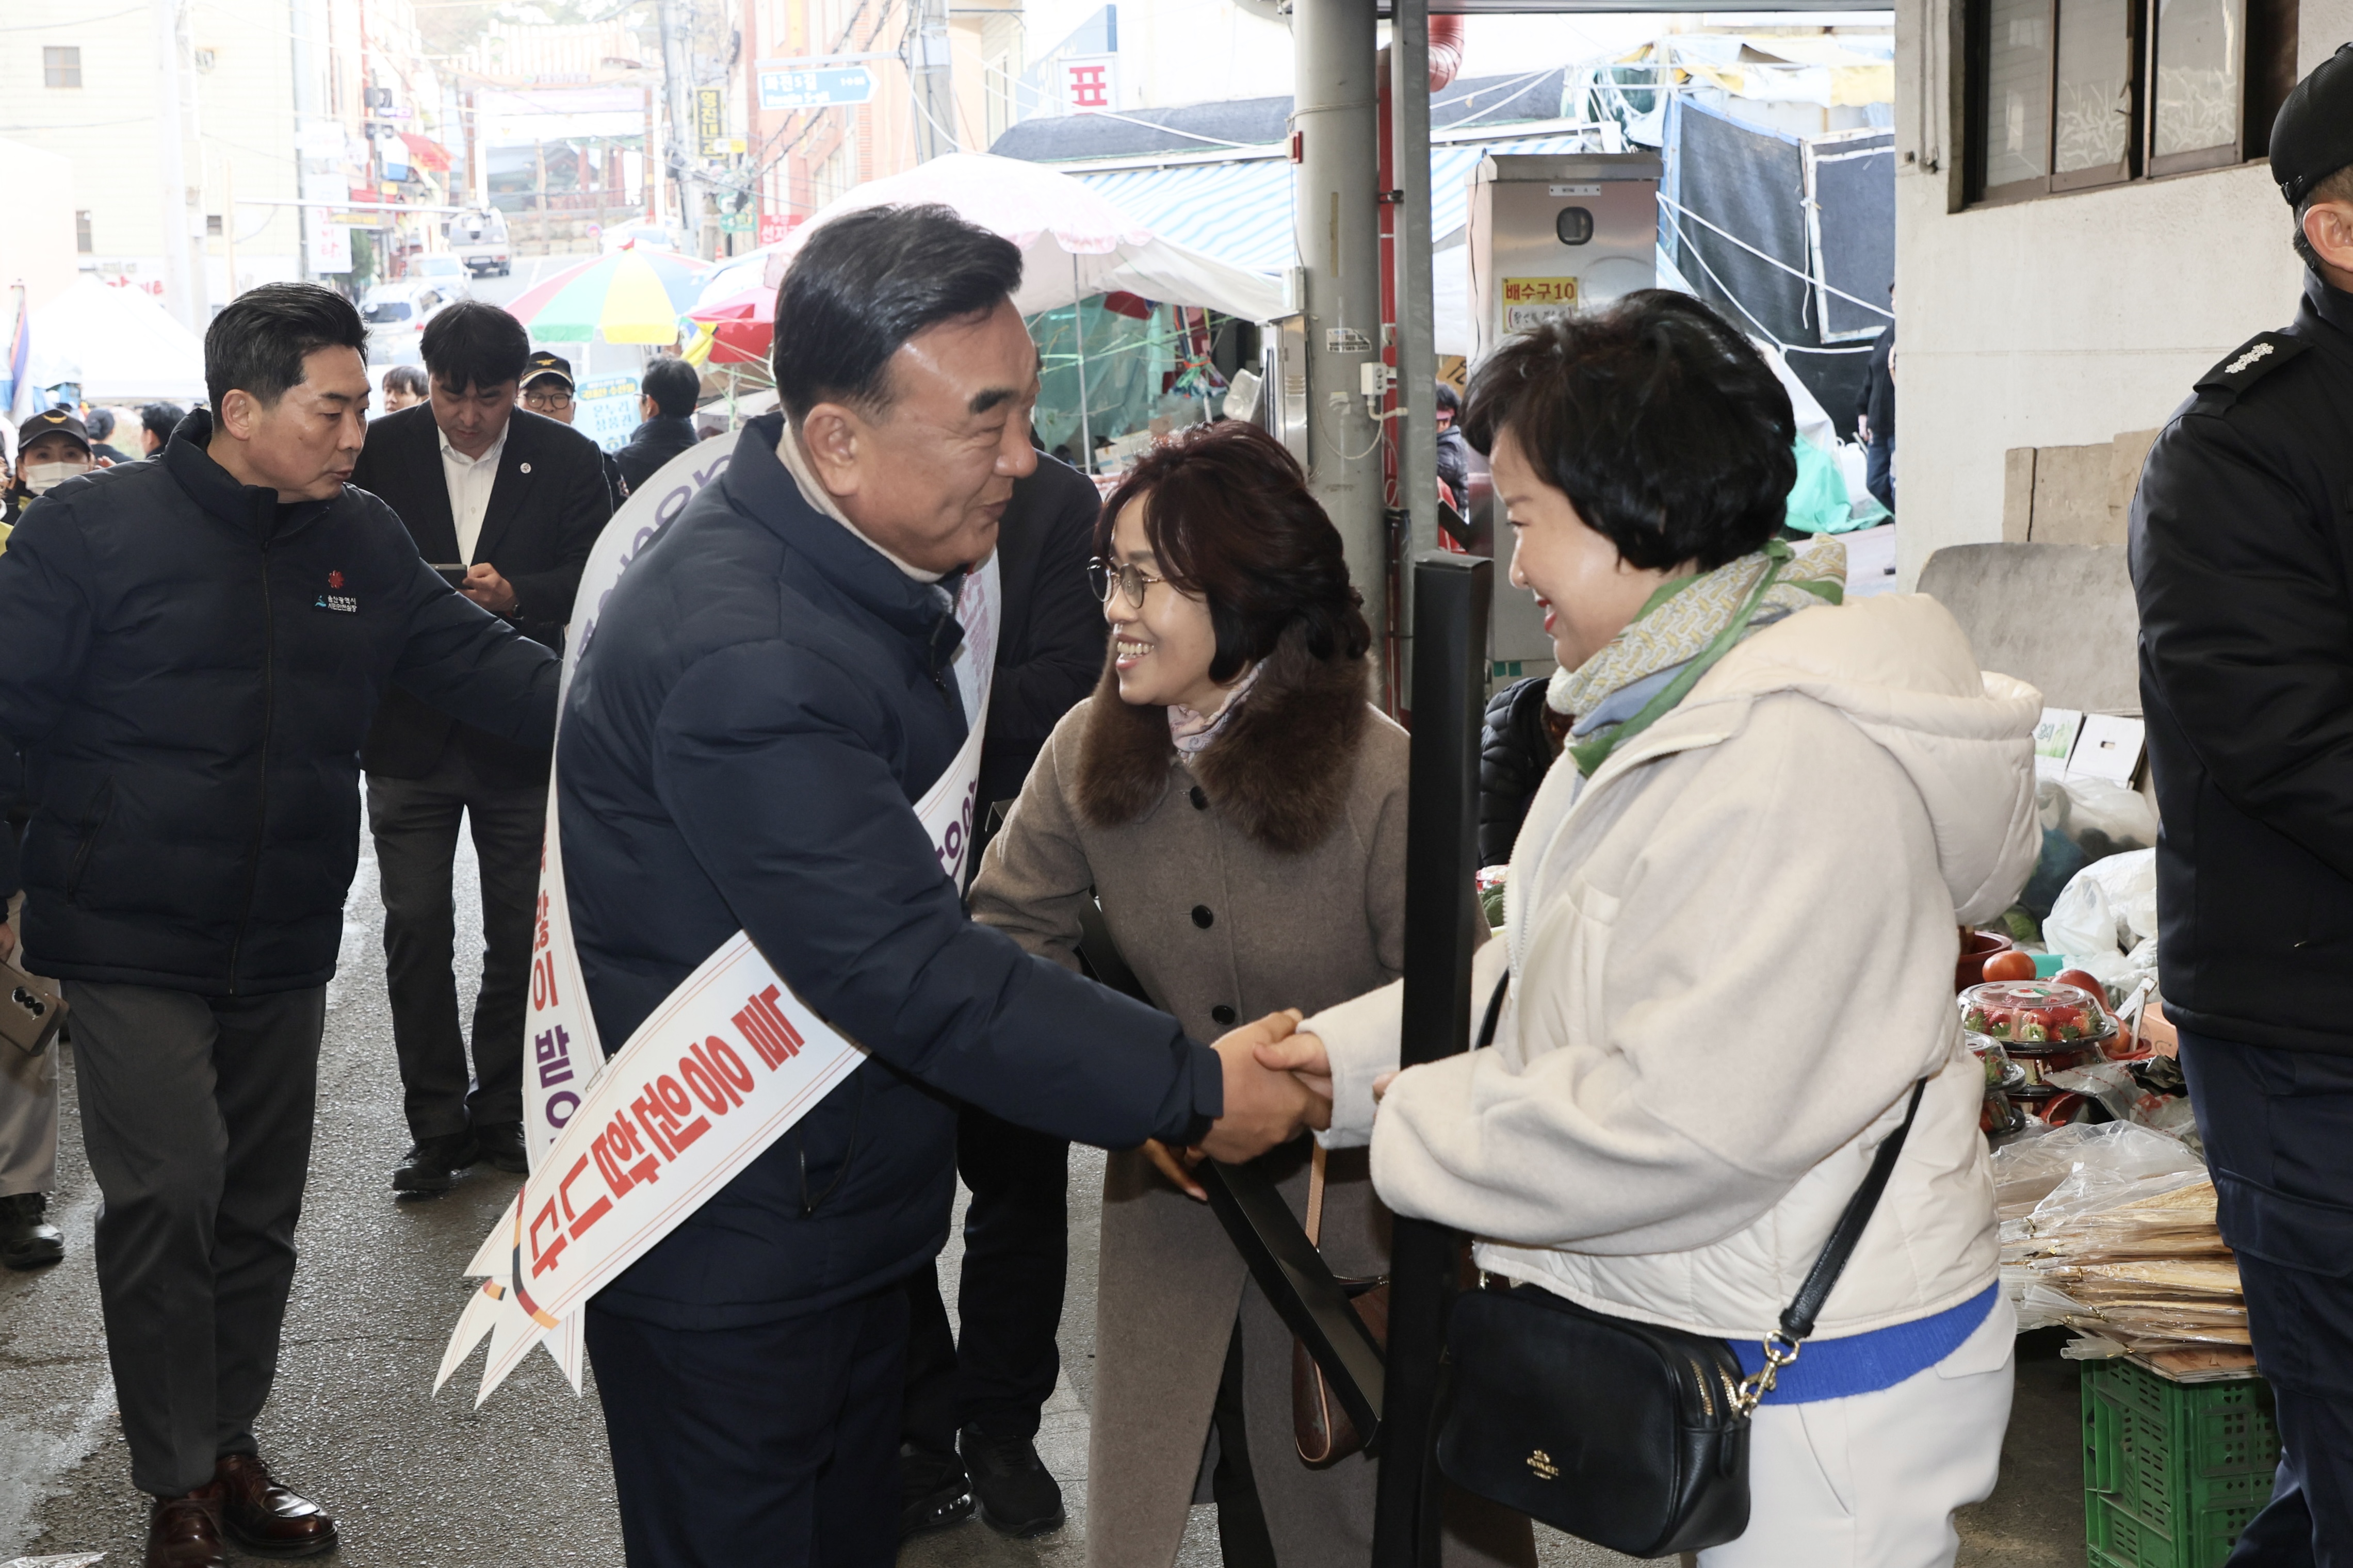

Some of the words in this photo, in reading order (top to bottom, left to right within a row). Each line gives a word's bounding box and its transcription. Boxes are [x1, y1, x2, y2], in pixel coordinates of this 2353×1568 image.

[328, 595, 356, 605] 울산광역시
[328, 602, 358, 613] 시민안전실장
[731, 983, 805, 1072] 늘
[529, 1035, 756, 1280] 응원합니다
